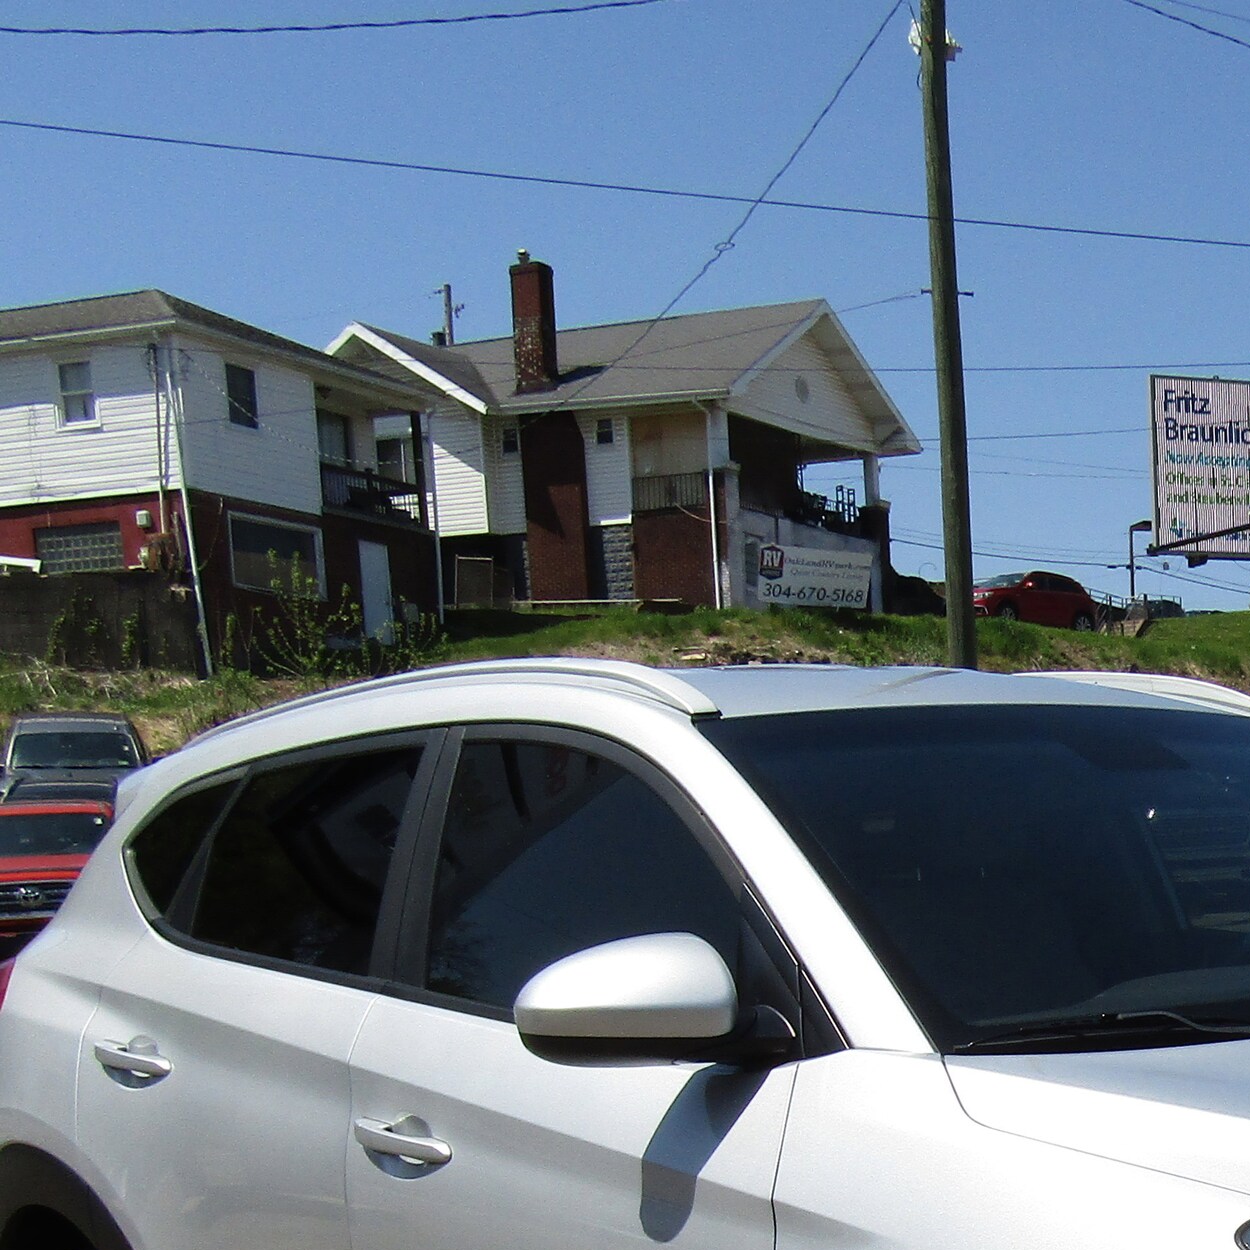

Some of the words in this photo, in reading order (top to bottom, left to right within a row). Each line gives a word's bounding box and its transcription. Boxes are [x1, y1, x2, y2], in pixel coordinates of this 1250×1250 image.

[1164, 389, 1211, 414] Fritz
[1165, 449, 1193, 465] Now
[763, 549, 781, 567] RV
[763, 582, 864, 602] 304-670-5168
